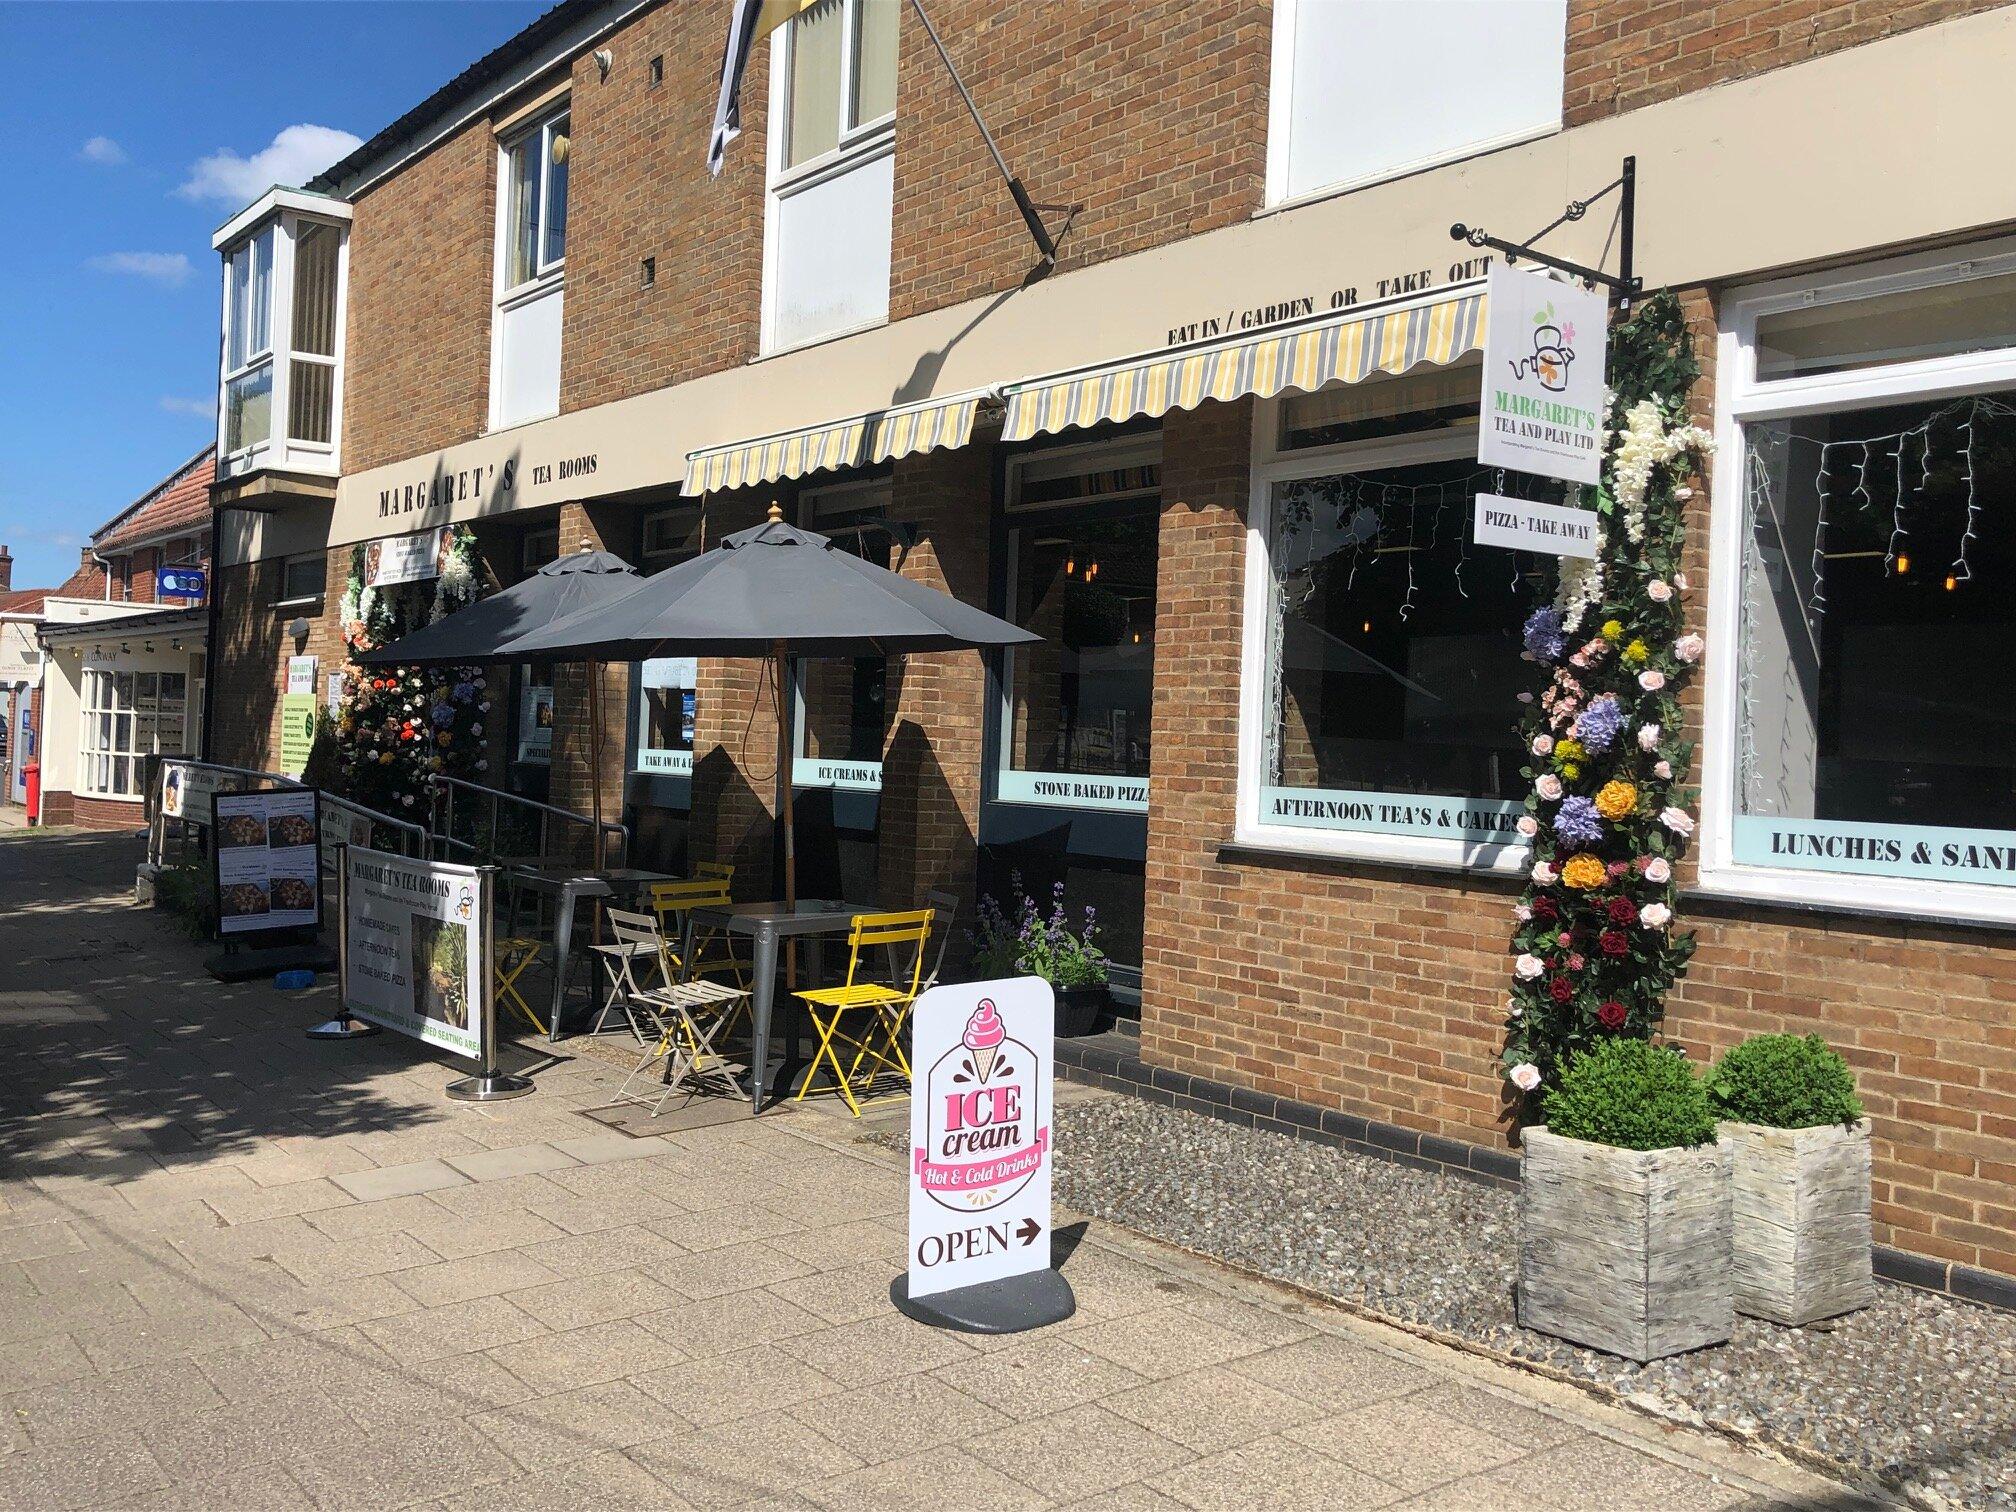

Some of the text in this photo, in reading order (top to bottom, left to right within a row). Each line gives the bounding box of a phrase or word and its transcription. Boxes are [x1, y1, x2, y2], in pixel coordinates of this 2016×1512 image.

[1167, 255, 1493, 346] EAT IN / GARDEN OR TAKE OUT
[1494, 390, 1596, 431] MARGARET'S
[1494, 416, 1594, 450] TEA AND PLAY LTD
[378, 453, 598, 518] MARGARET'S TEA ROOMS
[1485, 510, 1518, 529] PIZZA
[1527, 517, 1558, 535] TAKE
[1560, 522, 1591, 540] AWAY
[645, 756, 661, 767] TAKE
[664, 757, 680, 768] AWAY
[682, 758, 687, 768] &
[818, 767, 832, 779] ICE
[834, 768, 868, 781] CREAMS
[870, 770, 876, 782] &
[1034, 781, 1071, 797] STONE
[1074, 783, 1114, 800] BAKED
[1272, 798, 1374, 822] AFTERNOON
[1379, 804, 1432, 826] TEA'S
[1437, 809, 1451, 827] &
[1771, 832, 1901, 863] LUNCHES
[1911, 842, 1932, 865] &
[353, 862, 451, 898] MARGARET'S TEA ROOMS
[359, 939, 388, 955] AFTERNOON
[374, 969, 391, 982] BAKED
[392, 973, 406, 988] PIZZA
[437, 1029, 463, 1047] SEATING
[464, 1039, 480, 1052] AREA
[945, 1085, 1021, 1132] ICE
[942, 1124, 1023, 1159] cream
[925, 1152, 1039, 1186] Hot & Cold Drinks
[917, 1221, 1011, 1267] OPEN
